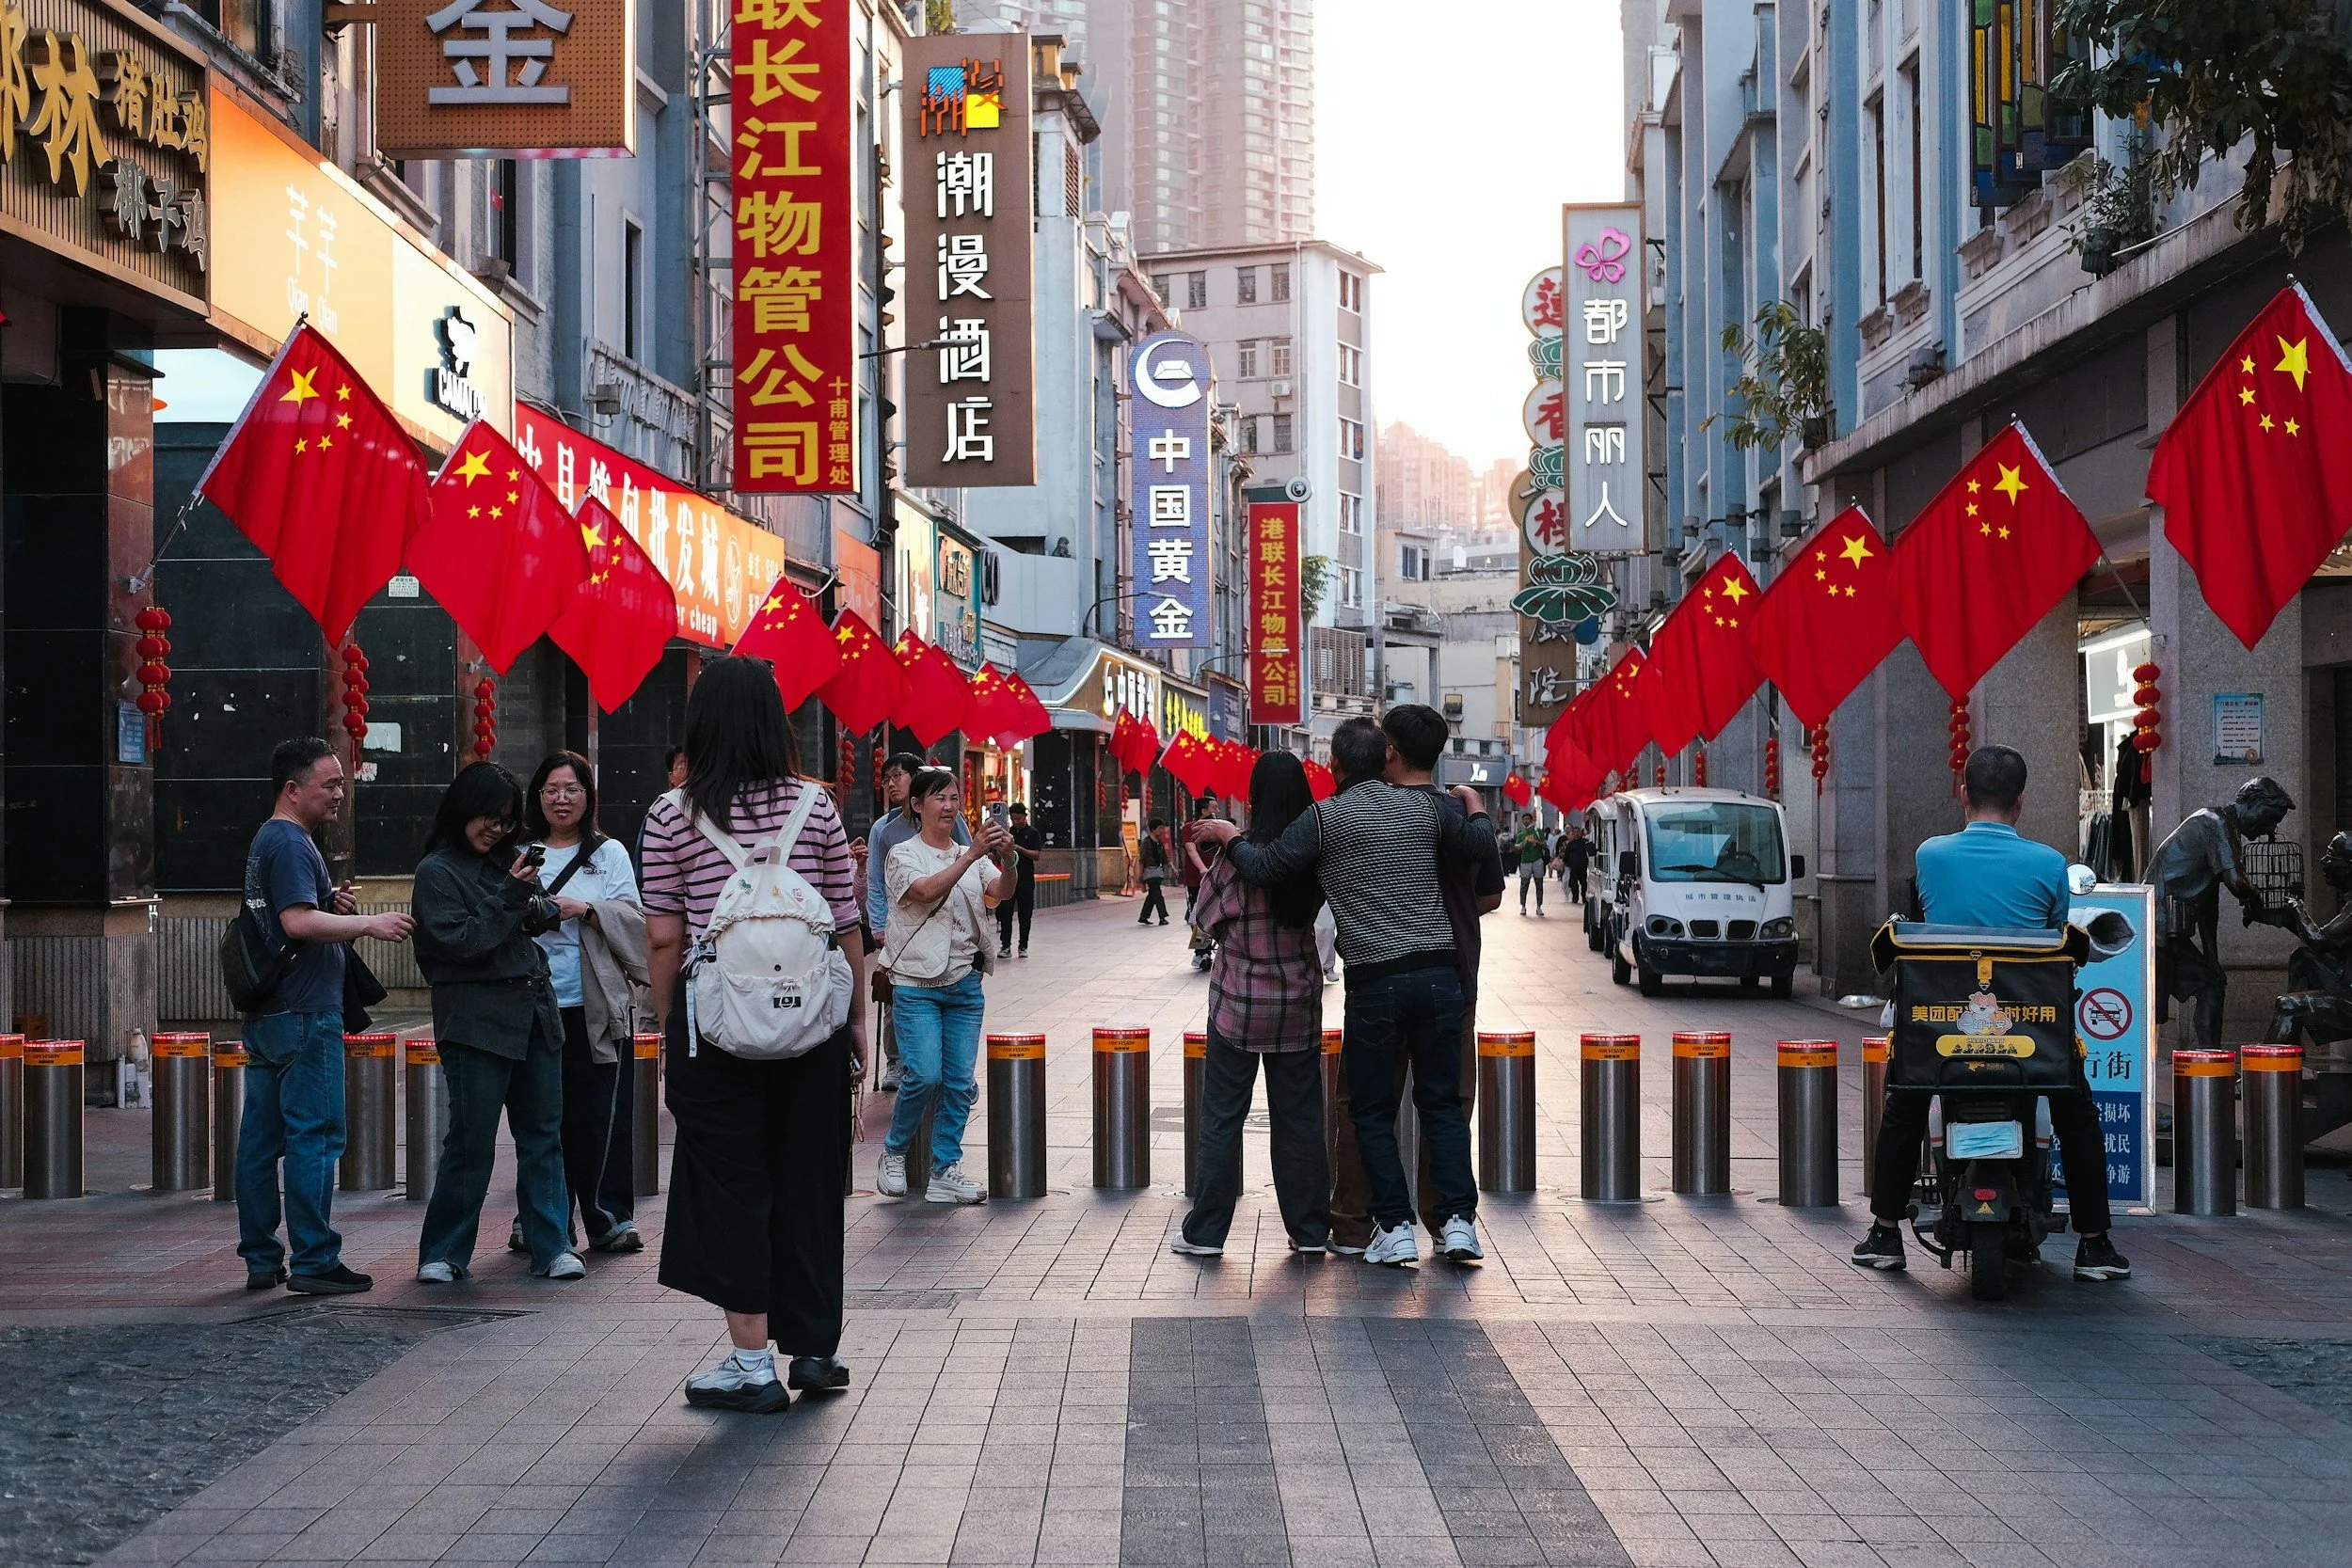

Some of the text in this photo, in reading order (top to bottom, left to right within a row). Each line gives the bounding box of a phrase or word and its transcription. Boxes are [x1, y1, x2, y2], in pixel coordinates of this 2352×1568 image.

[425, 0, 574, 104] 金
[113, 50, 207, 173] 猪肚鸡
[113, 158, 207, 272] 椰子鸡
[285, 183, 339, 295] 芊芊
[287, 276, 339, 336] Qian Qian
[936, 150, 994, 464] 潮漫酒店
[827, 376, 850, 485] 十甫管理处
[1583, 298, 1629, 528] 都市丽人
[1148, 428, 1194, 640] 中国黄金
[690, 604, 718, 642] cheap
[1260, 517, 1287, 706] 港联长江物管公司
[1911, 1005, 2057, 1024] 美团配时好用
